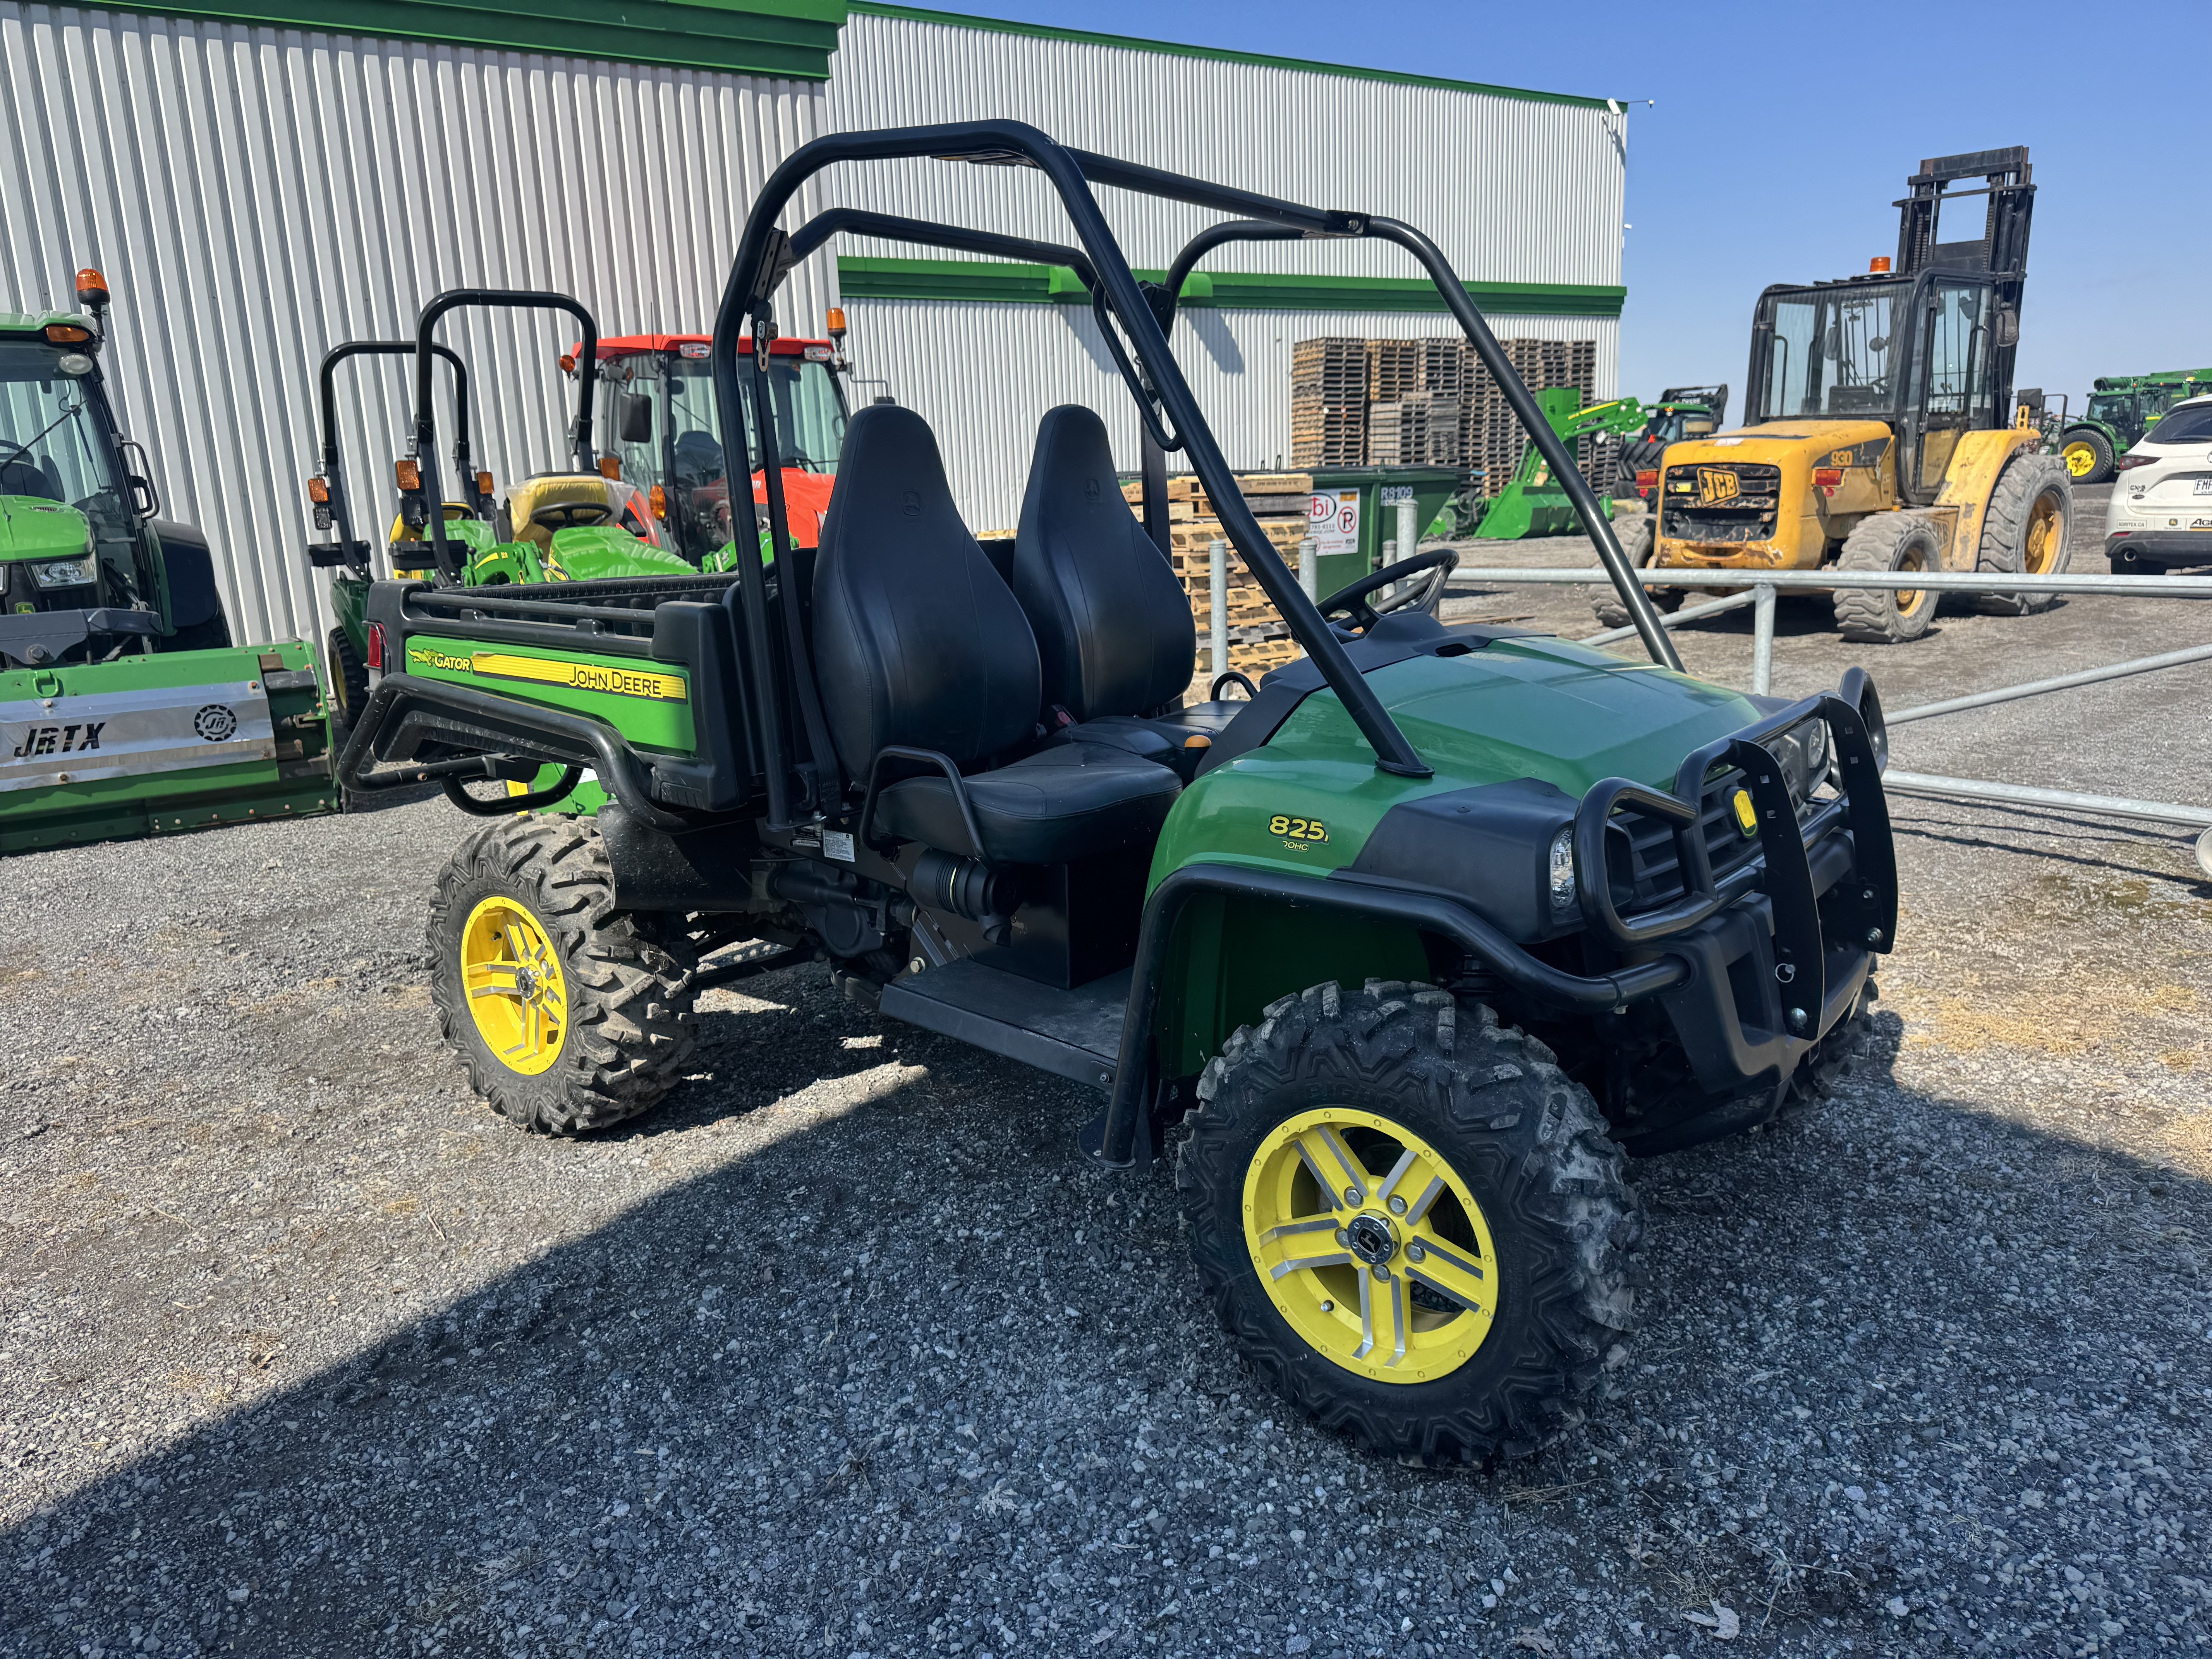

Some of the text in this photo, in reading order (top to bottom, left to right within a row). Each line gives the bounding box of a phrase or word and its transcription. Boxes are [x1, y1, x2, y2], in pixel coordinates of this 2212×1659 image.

[1831, 451, 1853, 466] 930
[1381, 486, 1413, 499] R8109
[1704, 471, 1736, 502] JCB
[1306, 497, 1329, 517] bi
[435, 653, 470, 671] GATOR
[569, 666, 661, 695] JOHN DEERE
[14, 722, 106, 757] JRTX
